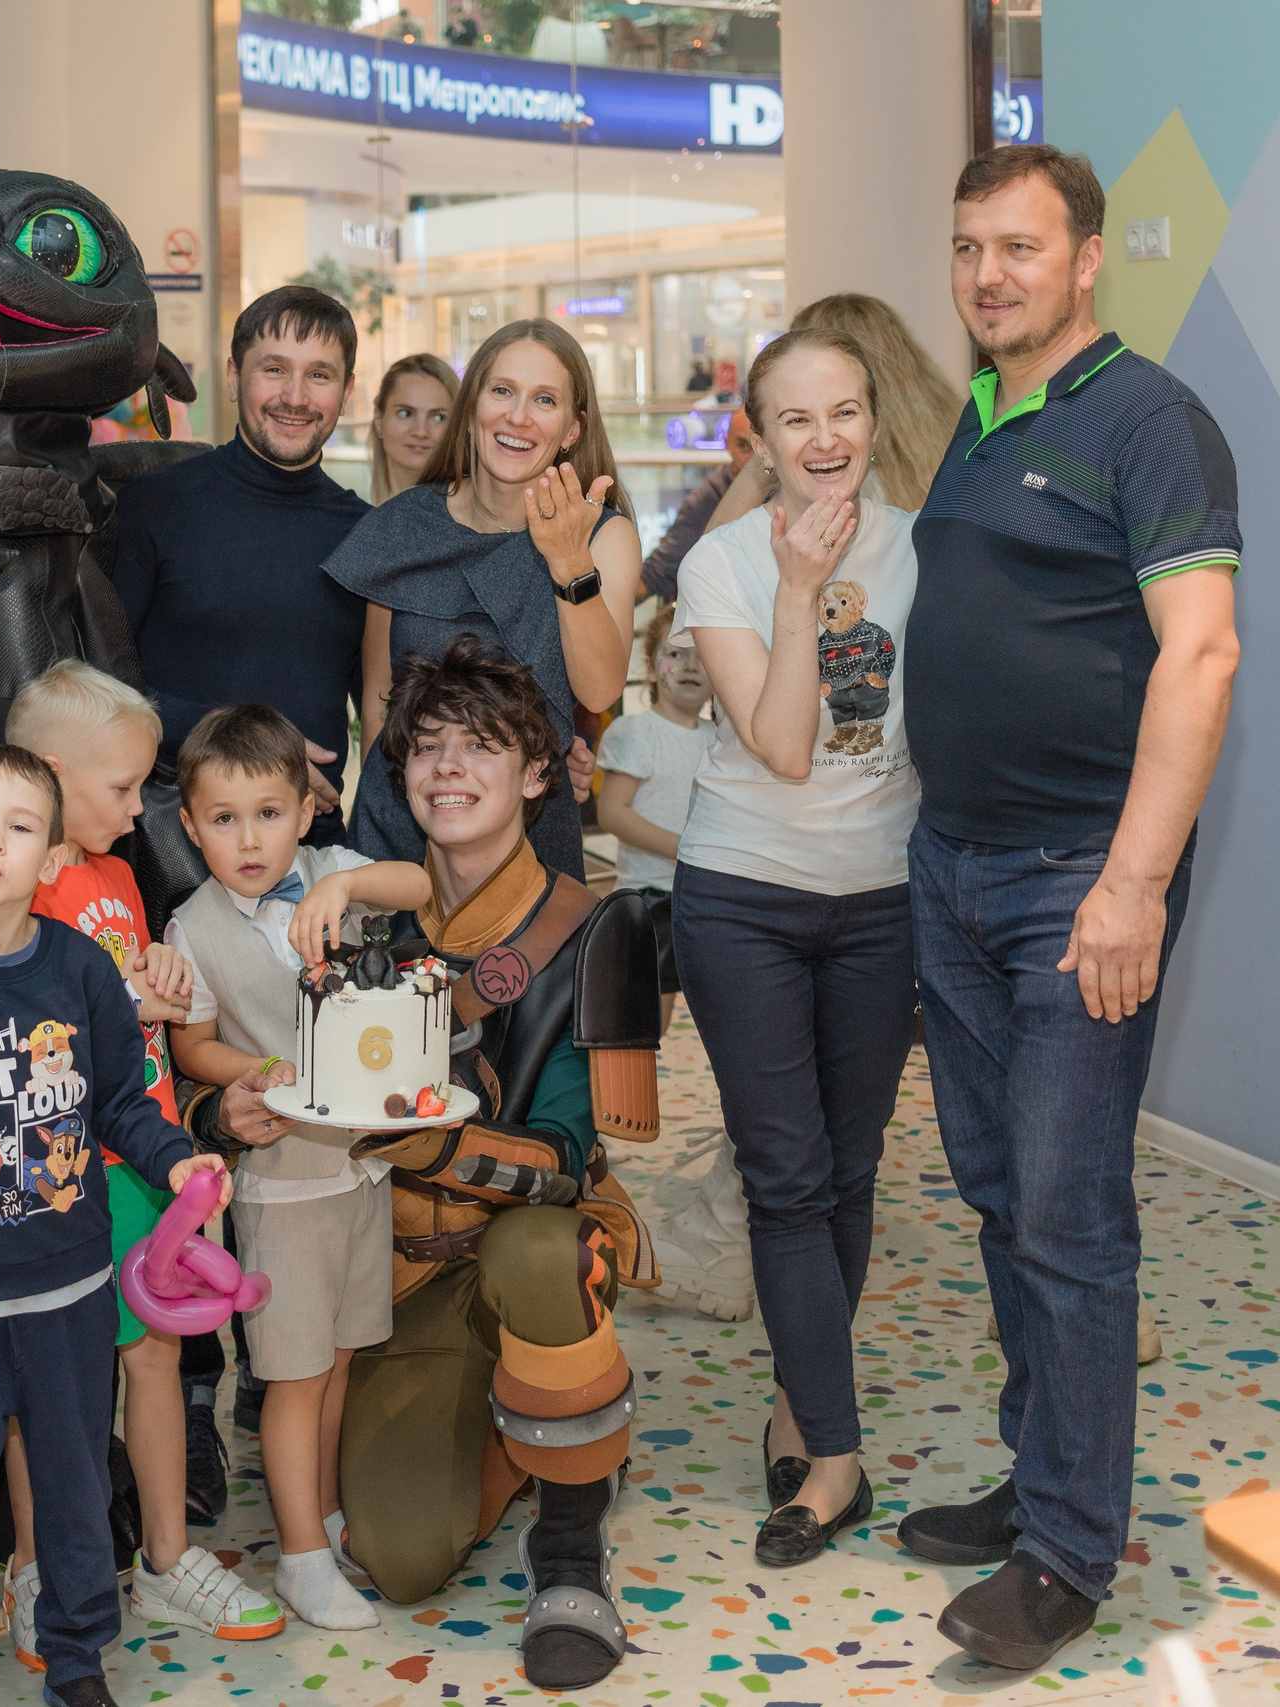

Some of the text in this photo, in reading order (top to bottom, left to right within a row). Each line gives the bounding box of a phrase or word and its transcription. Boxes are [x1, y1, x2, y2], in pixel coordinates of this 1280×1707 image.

[350, 54, 371, 100] В
[372, 58, 412, 113] ТЦ
[413, 64, 586, 124] Метрополис
[1024, 472, 1048, 486] BOSS
[838, 758, 847, 767] by
[851, 755, 884, 766] RALPH
[74, 897, 134, 936] RY DAY
[358, 1025, 393, 1070] 6
[18, 1076, 87, 1121] LOUD
[1, 1200, 22, 1218] FUN
[2, 1190, 18, 1204] SO
